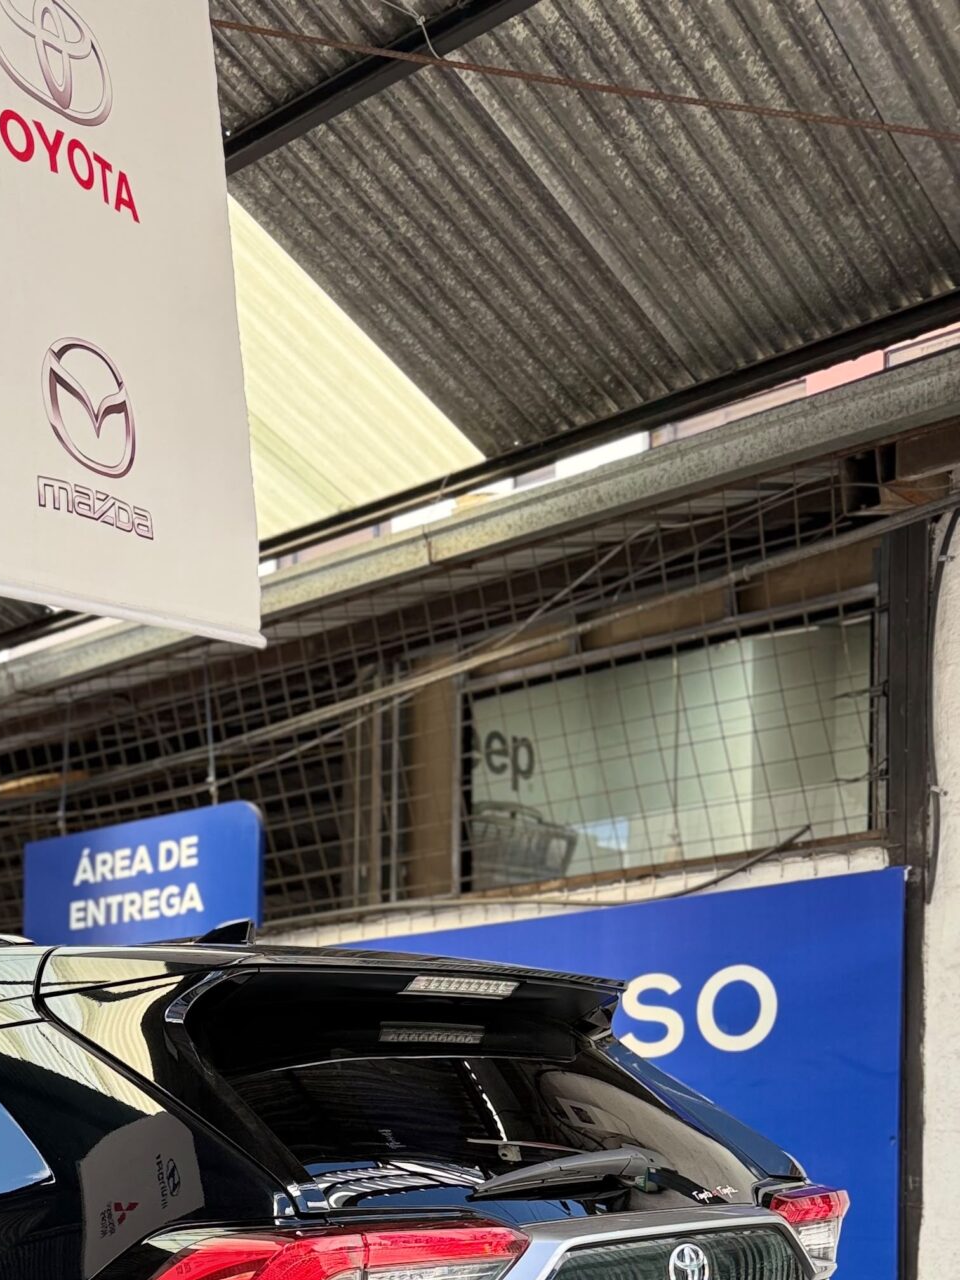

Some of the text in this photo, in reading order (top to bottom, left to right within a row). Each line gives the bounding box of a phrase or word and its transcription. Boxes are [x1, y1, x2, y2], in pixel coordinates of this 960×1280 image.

[73, 834, 199, 887] ÁREA DE
[69, 881, 205, 931] ENTREGA
[619, 963, 779, 1059] SO
